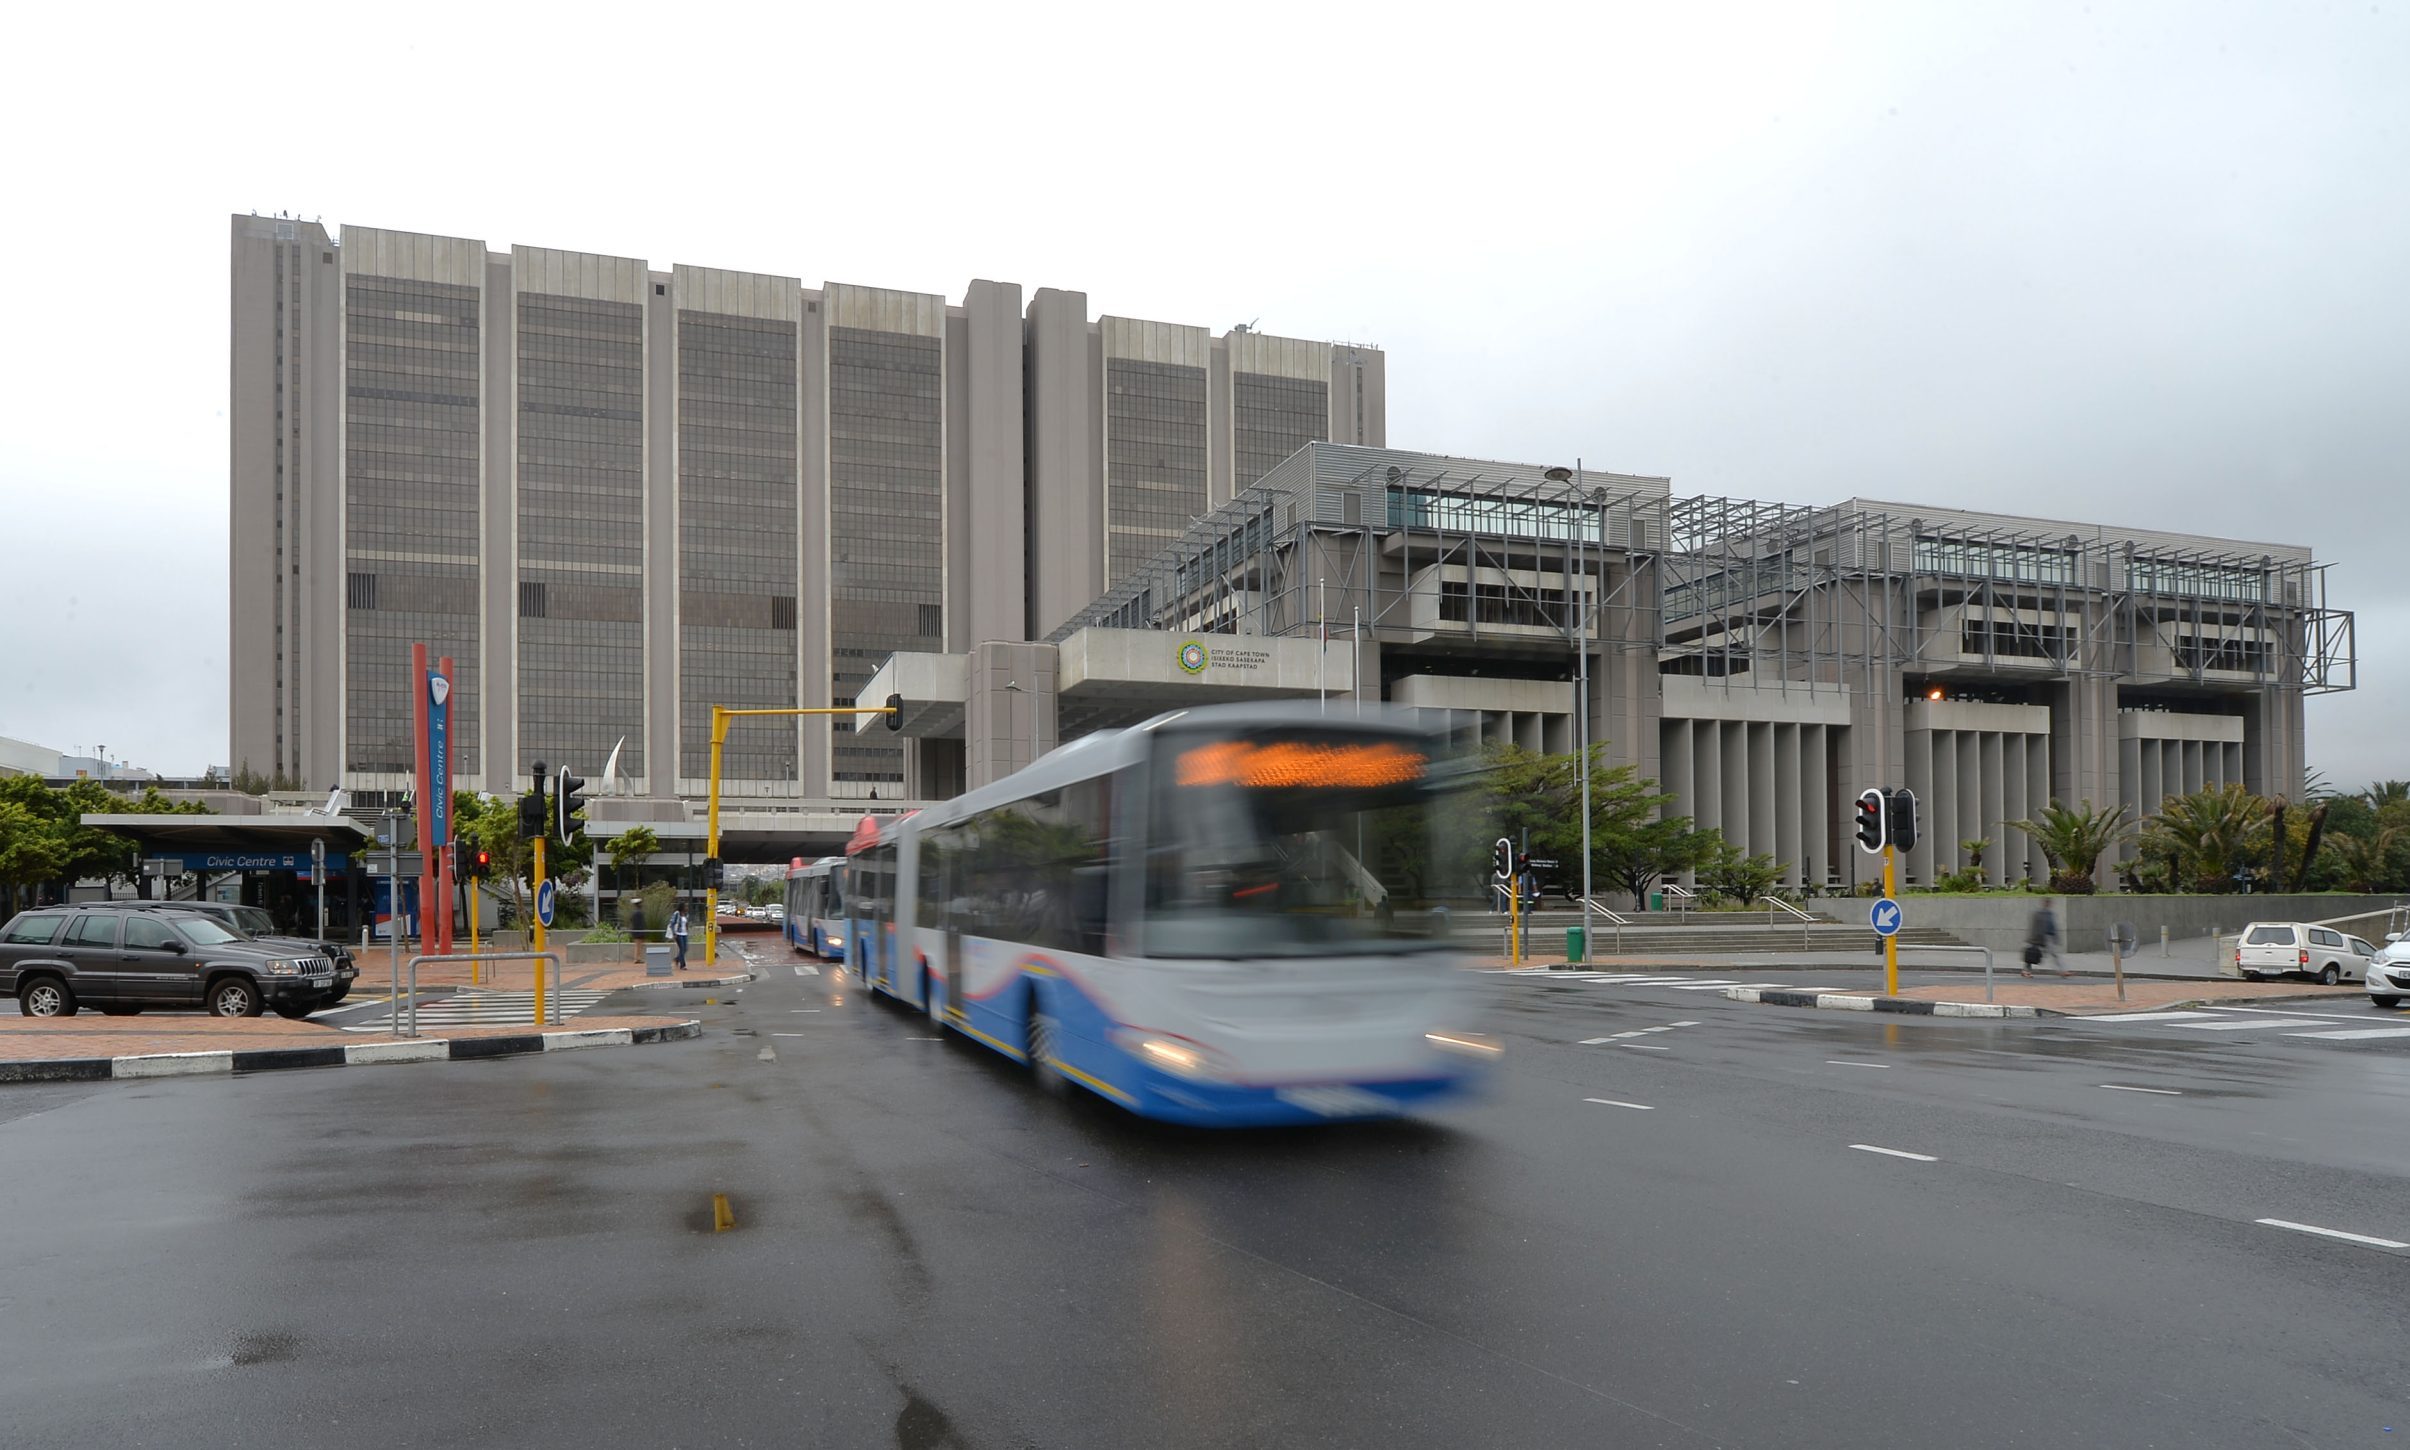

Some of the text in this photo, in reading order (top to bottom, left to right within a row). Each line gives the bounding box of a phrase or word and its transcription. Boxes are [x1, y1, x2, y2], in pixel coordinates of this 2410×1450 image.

[436, 740, 444, 819] Civic Centre
[207, 856, 276, 867] Civic Centre
